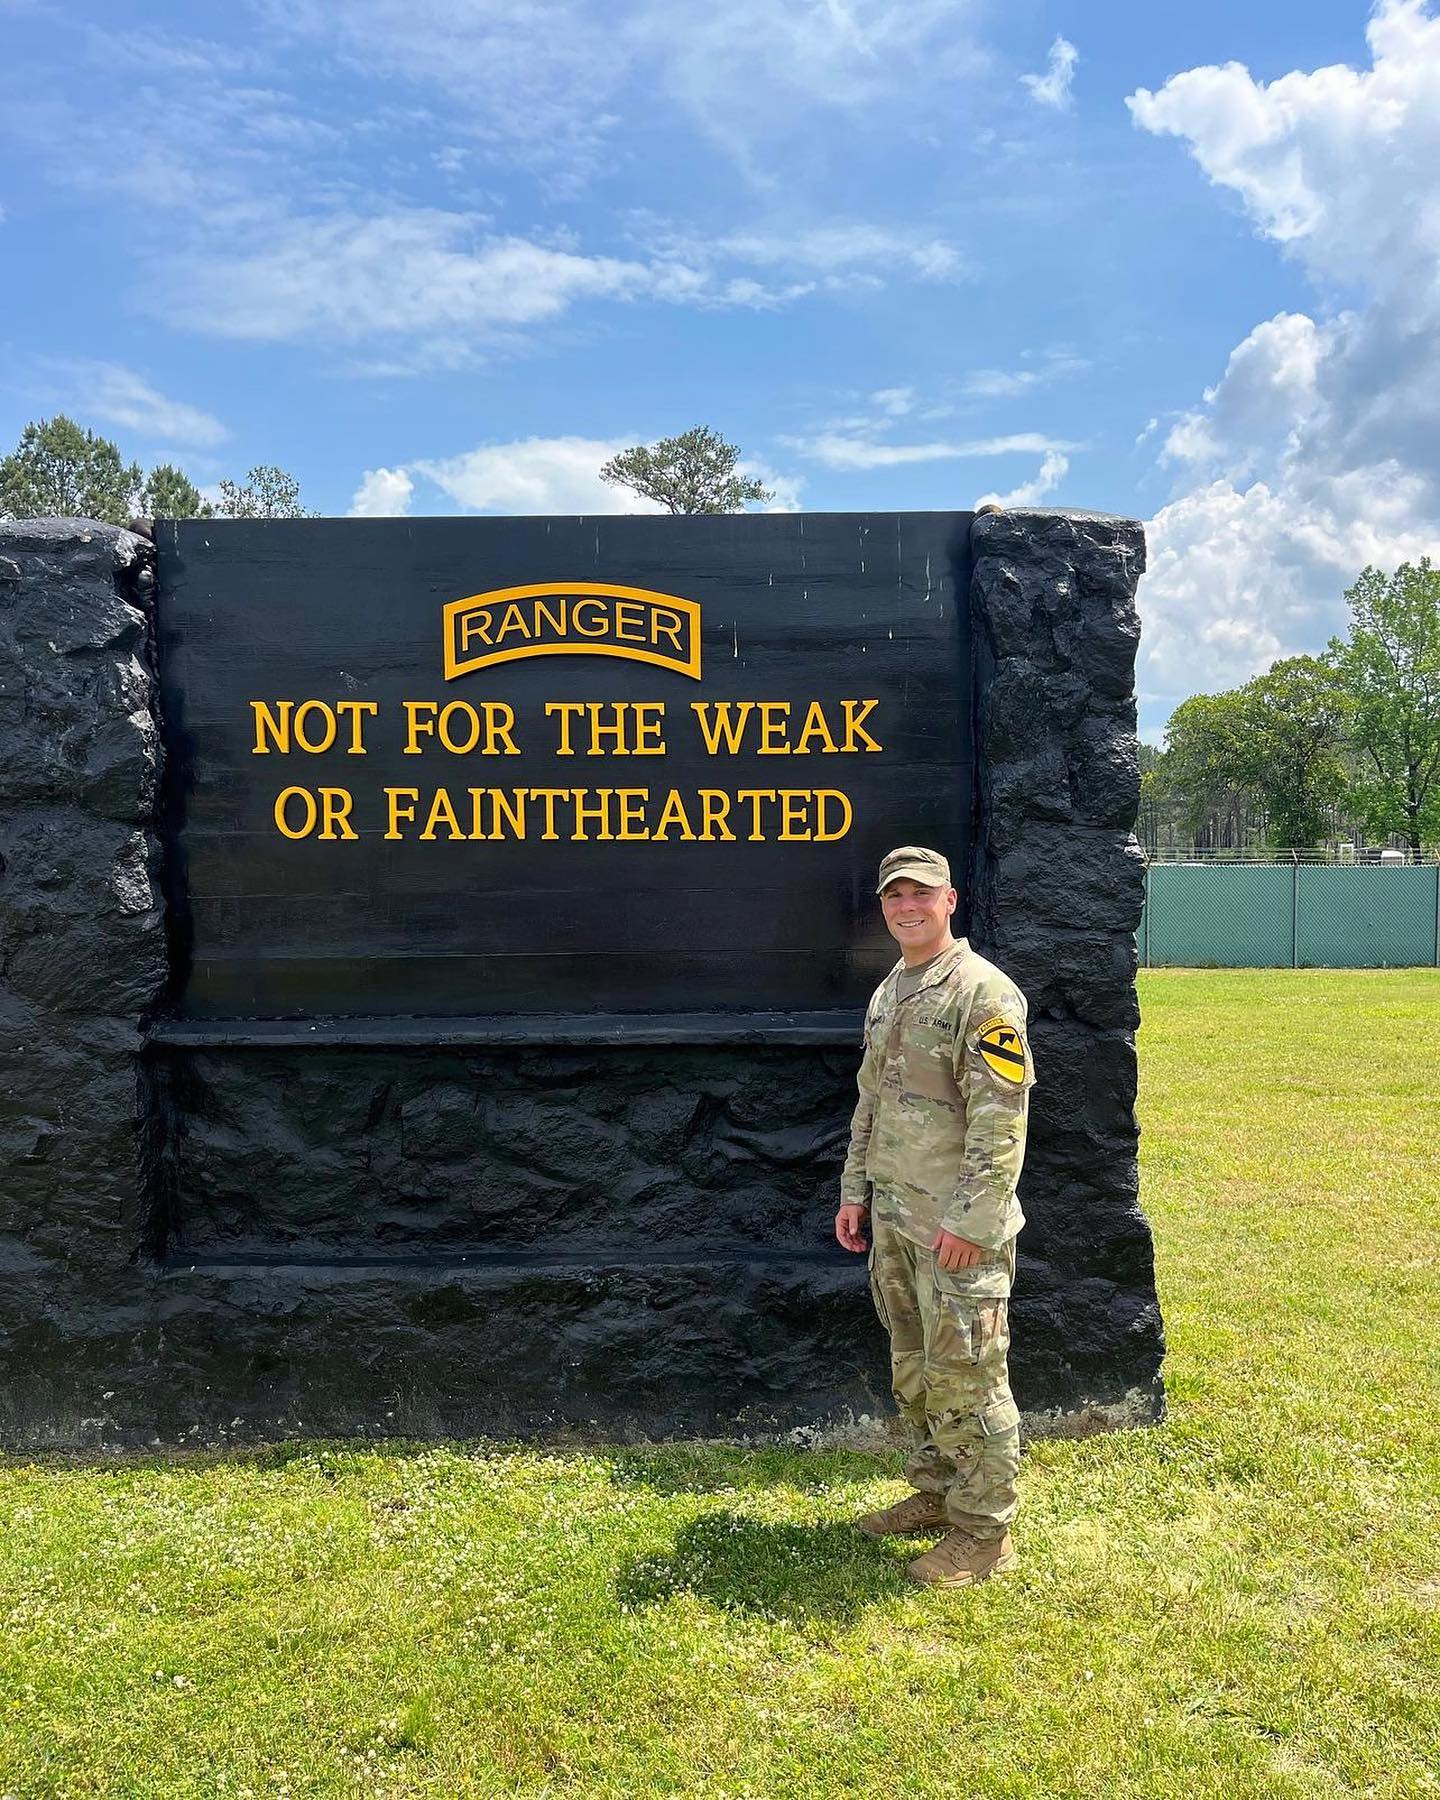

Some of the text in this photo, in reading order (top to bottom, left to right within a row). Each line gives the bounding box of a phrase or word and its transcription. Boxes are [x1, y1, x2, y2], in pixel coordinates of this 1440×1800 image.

[461, 599, 683, 651] RANGER
[251, 699, 883, 756] NOT FOR THE WEAK
[273, 785, 853, 842] OR FAINTHEARTED
[932, 1019, 952, 1030] ARMY
